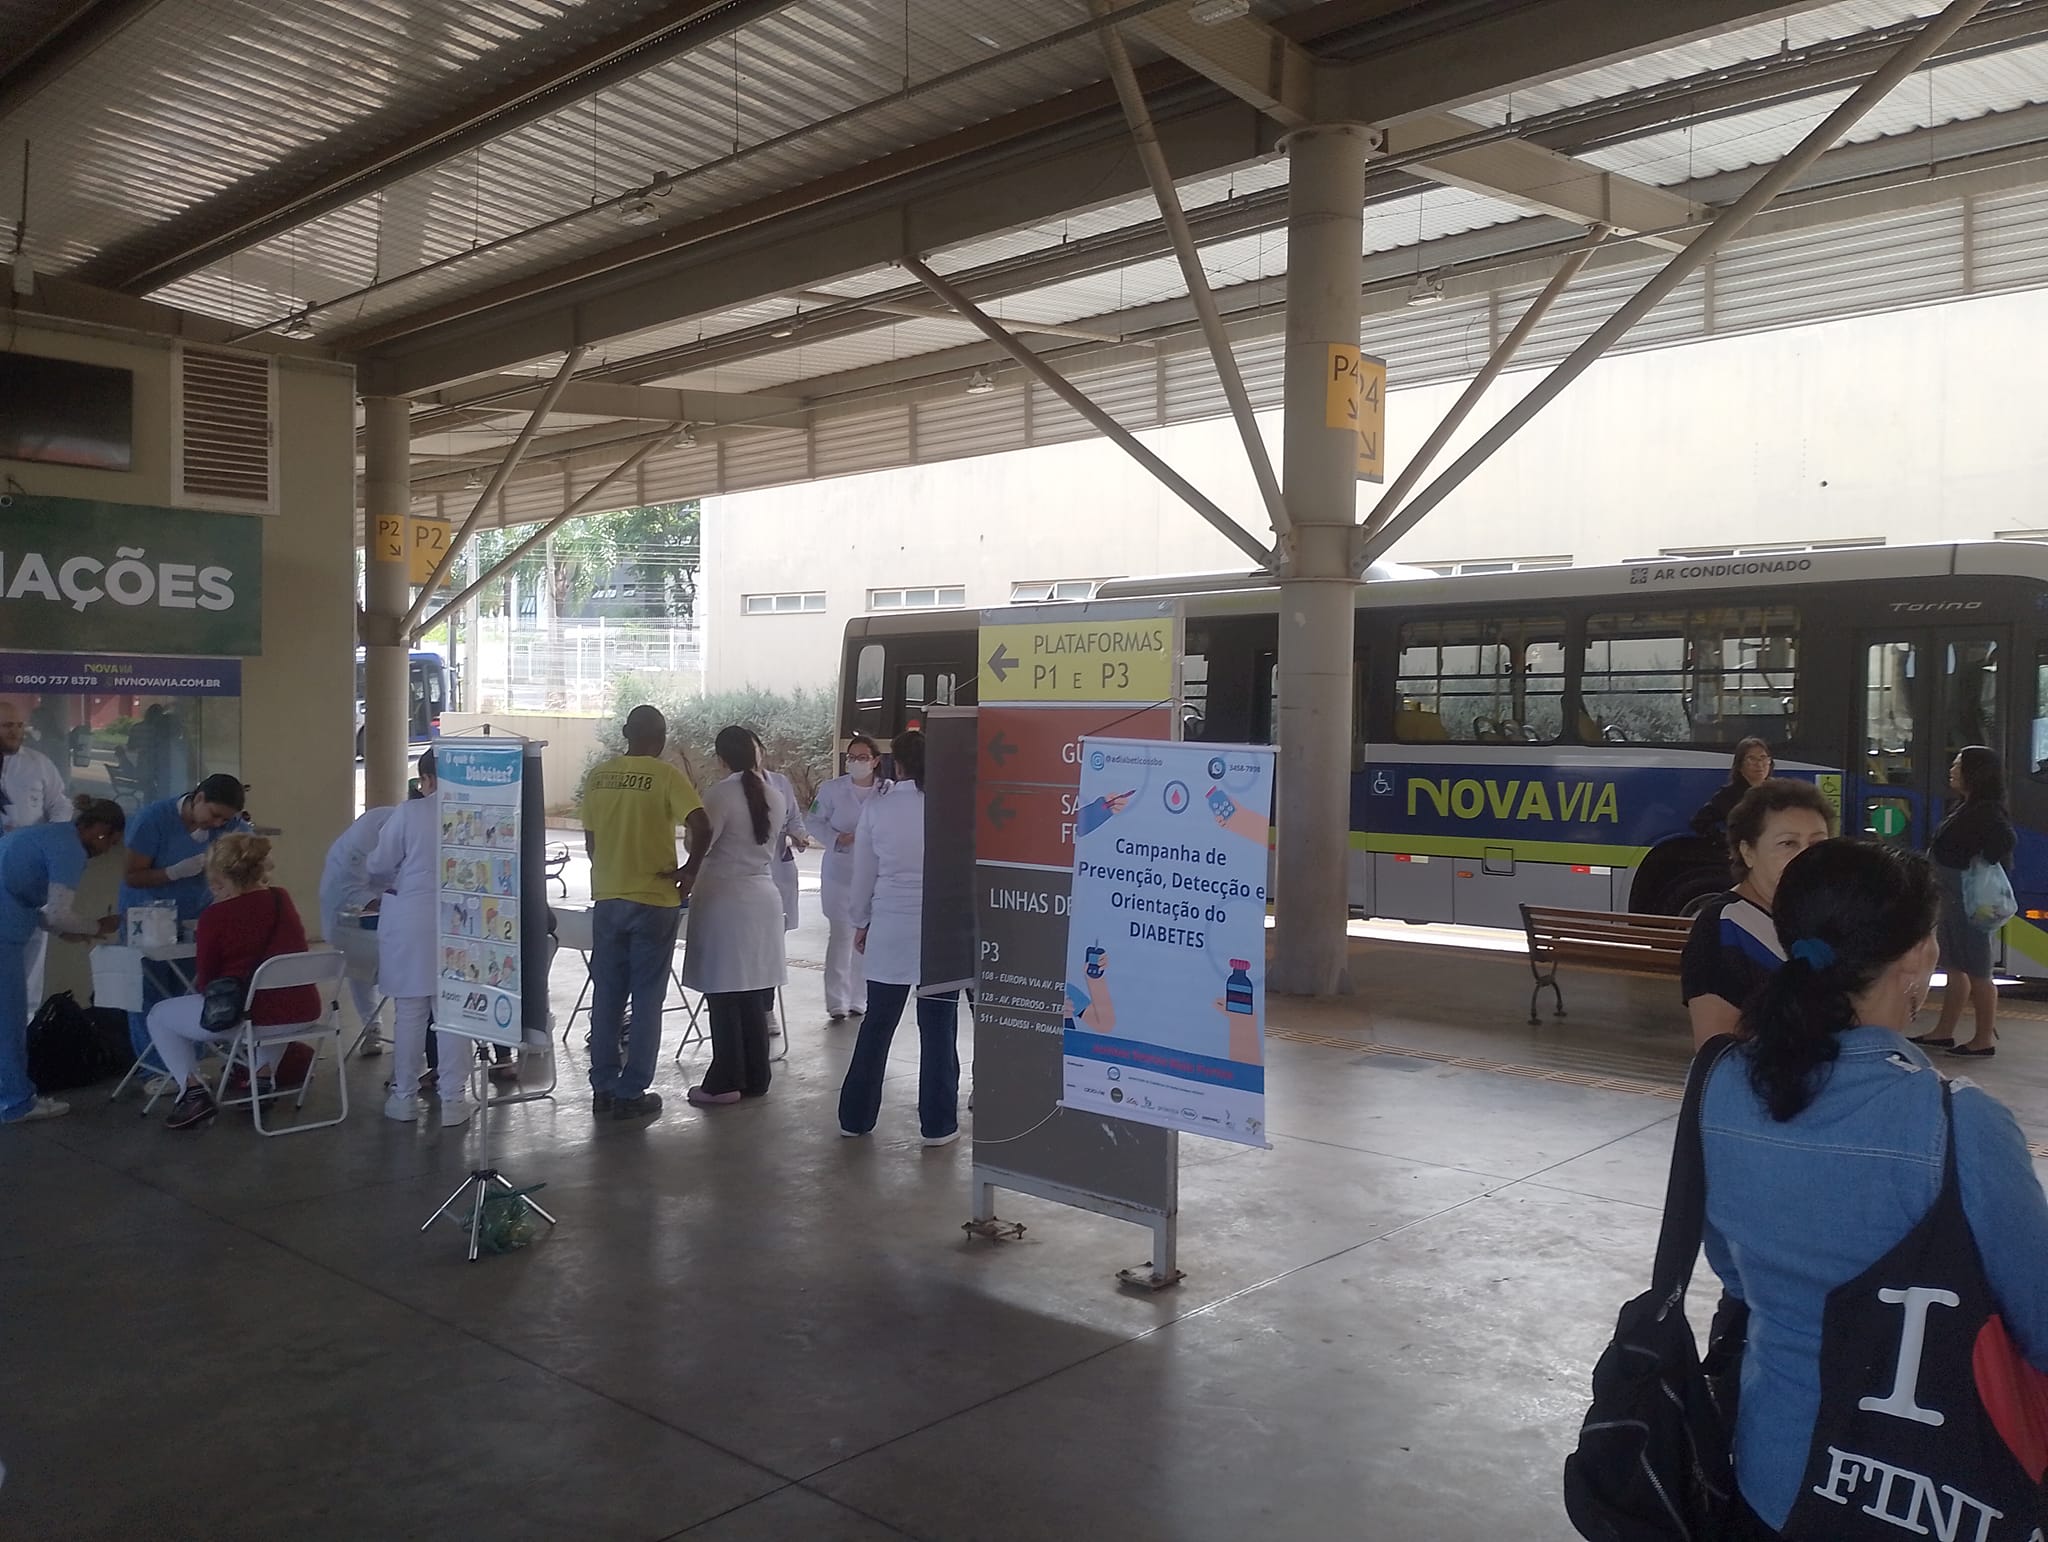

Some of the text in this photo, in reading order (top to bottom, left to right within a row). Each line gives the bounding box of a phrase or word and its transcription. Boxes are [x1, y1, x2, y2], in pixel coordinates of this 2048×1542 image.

[379, 520, 400, 537] P2
[416, 526, 443, 550] P2
[0, 546, 235, 613] AÇÕES
[1654, 559, 1812, 580] AR CONDICIONADO
[1889, 601, 1982, 612] Torino
[1034, 630, 1163, 655] PLATAFORMAS
[15, 675, 47, 685] 0800
[49, 675, 68, 685] 737
[114, 677, 221, 689] NVNOVAVIA.COM.BR
[1034, 662, 1129, 690] P1 E P3
[622, 775, 653, 790] 2018
[1115, 838, 1227, 866] Campanha de
[1079, 861, 1265, 900] Prevenção, Detecção e
[990, 887, 1049, 914] LINHAS
[1111, 891, 1226, 923] Orientação do
[1129, 921, 1205, 949] DIABETES
[981, 940, 1000, 962] P3
[1011, 996, 1045, 1011] PEDROSO
[1035, 1022, 1065, 1036] ROMAN
[1858, 1286, 1961, 1427] I
